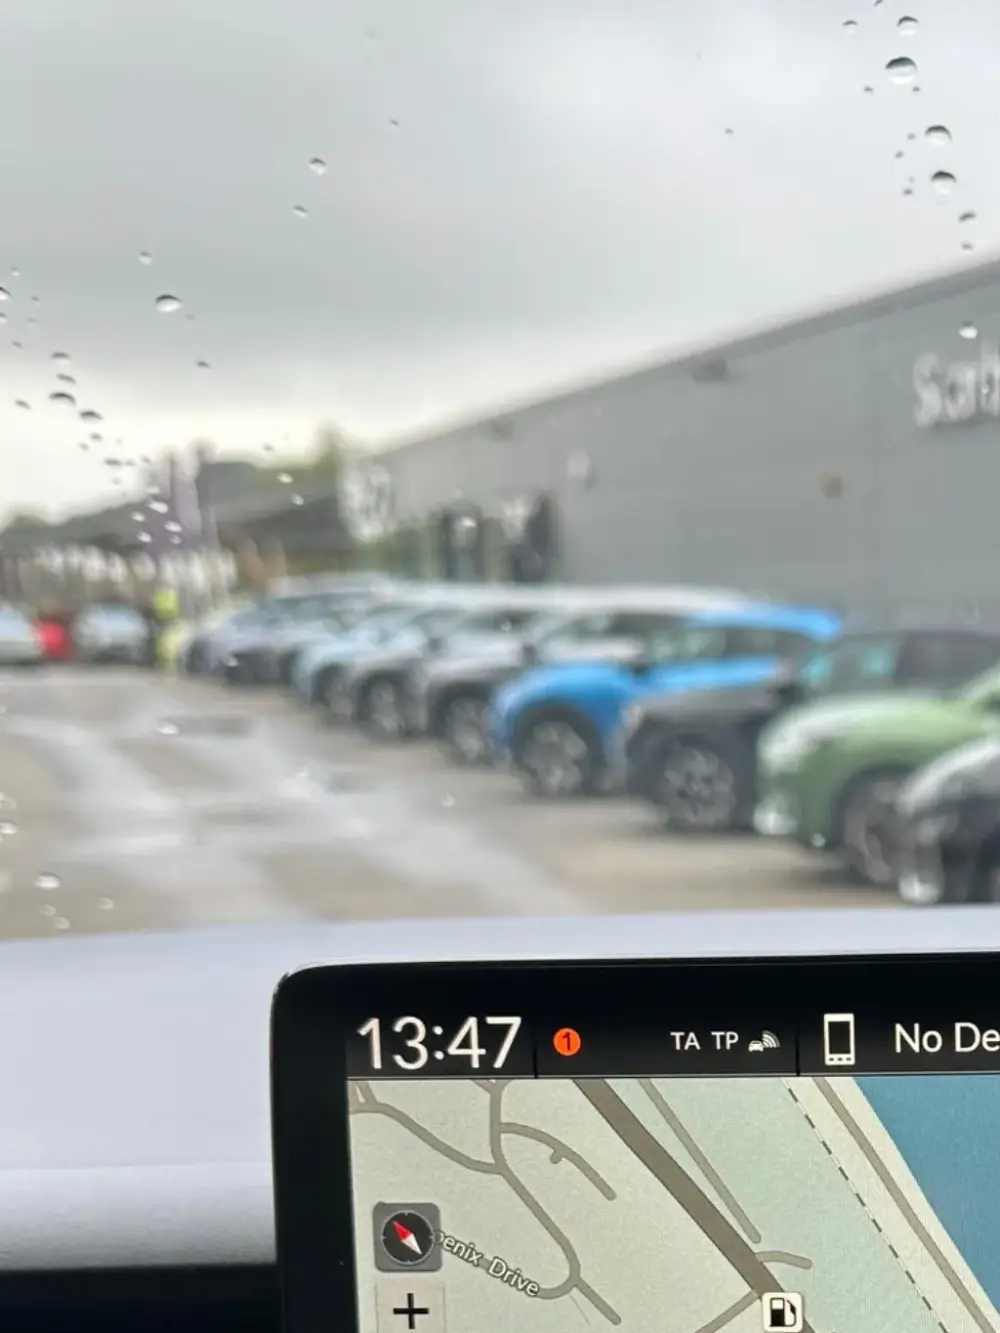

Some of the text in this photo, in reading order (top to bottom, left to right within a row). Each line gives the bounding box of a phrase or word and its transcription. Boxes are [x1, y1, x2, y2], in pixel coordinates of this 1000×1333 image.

[357, 1016, 522, 1070] 13:47
[670, 1031, 739, 1051] TA TP
[895, 1022, 943, 1054] No
[487, 1256, 540, 1297] Drive
